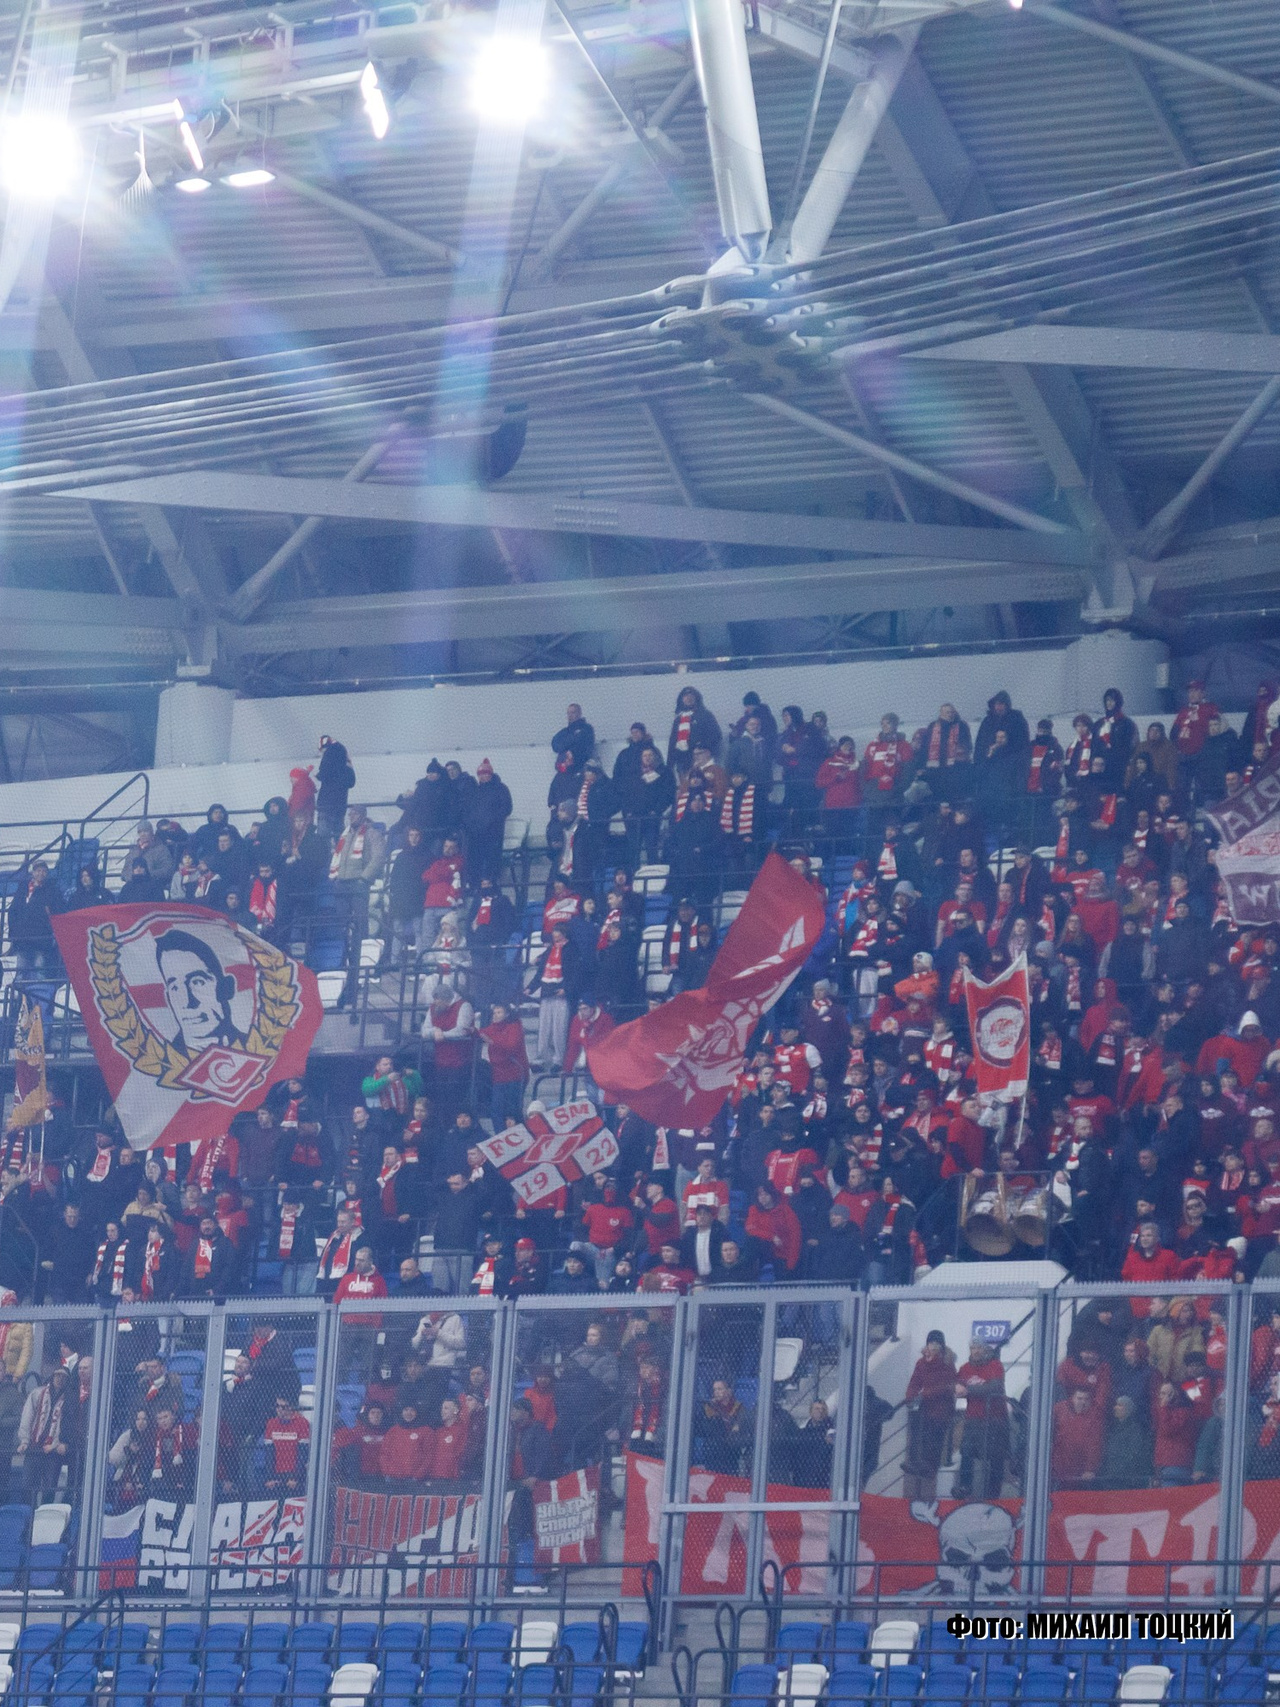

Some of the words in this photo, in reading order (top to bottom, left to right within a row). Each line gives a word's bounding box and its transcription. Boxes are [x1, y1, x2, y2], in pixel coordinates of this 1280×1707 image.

[554, 1103, 590, 1126] SM
[487, 1133, 524, 1159] FC
[585, 1137, 616, 1166] 22
[522, 1172, 549, 1198] 19
[984, 1325, 1006, 1337] 307
[141, 1498, 308, 1550] СЛАВА
[138, 1542, 305, 1590] РОСИИ
